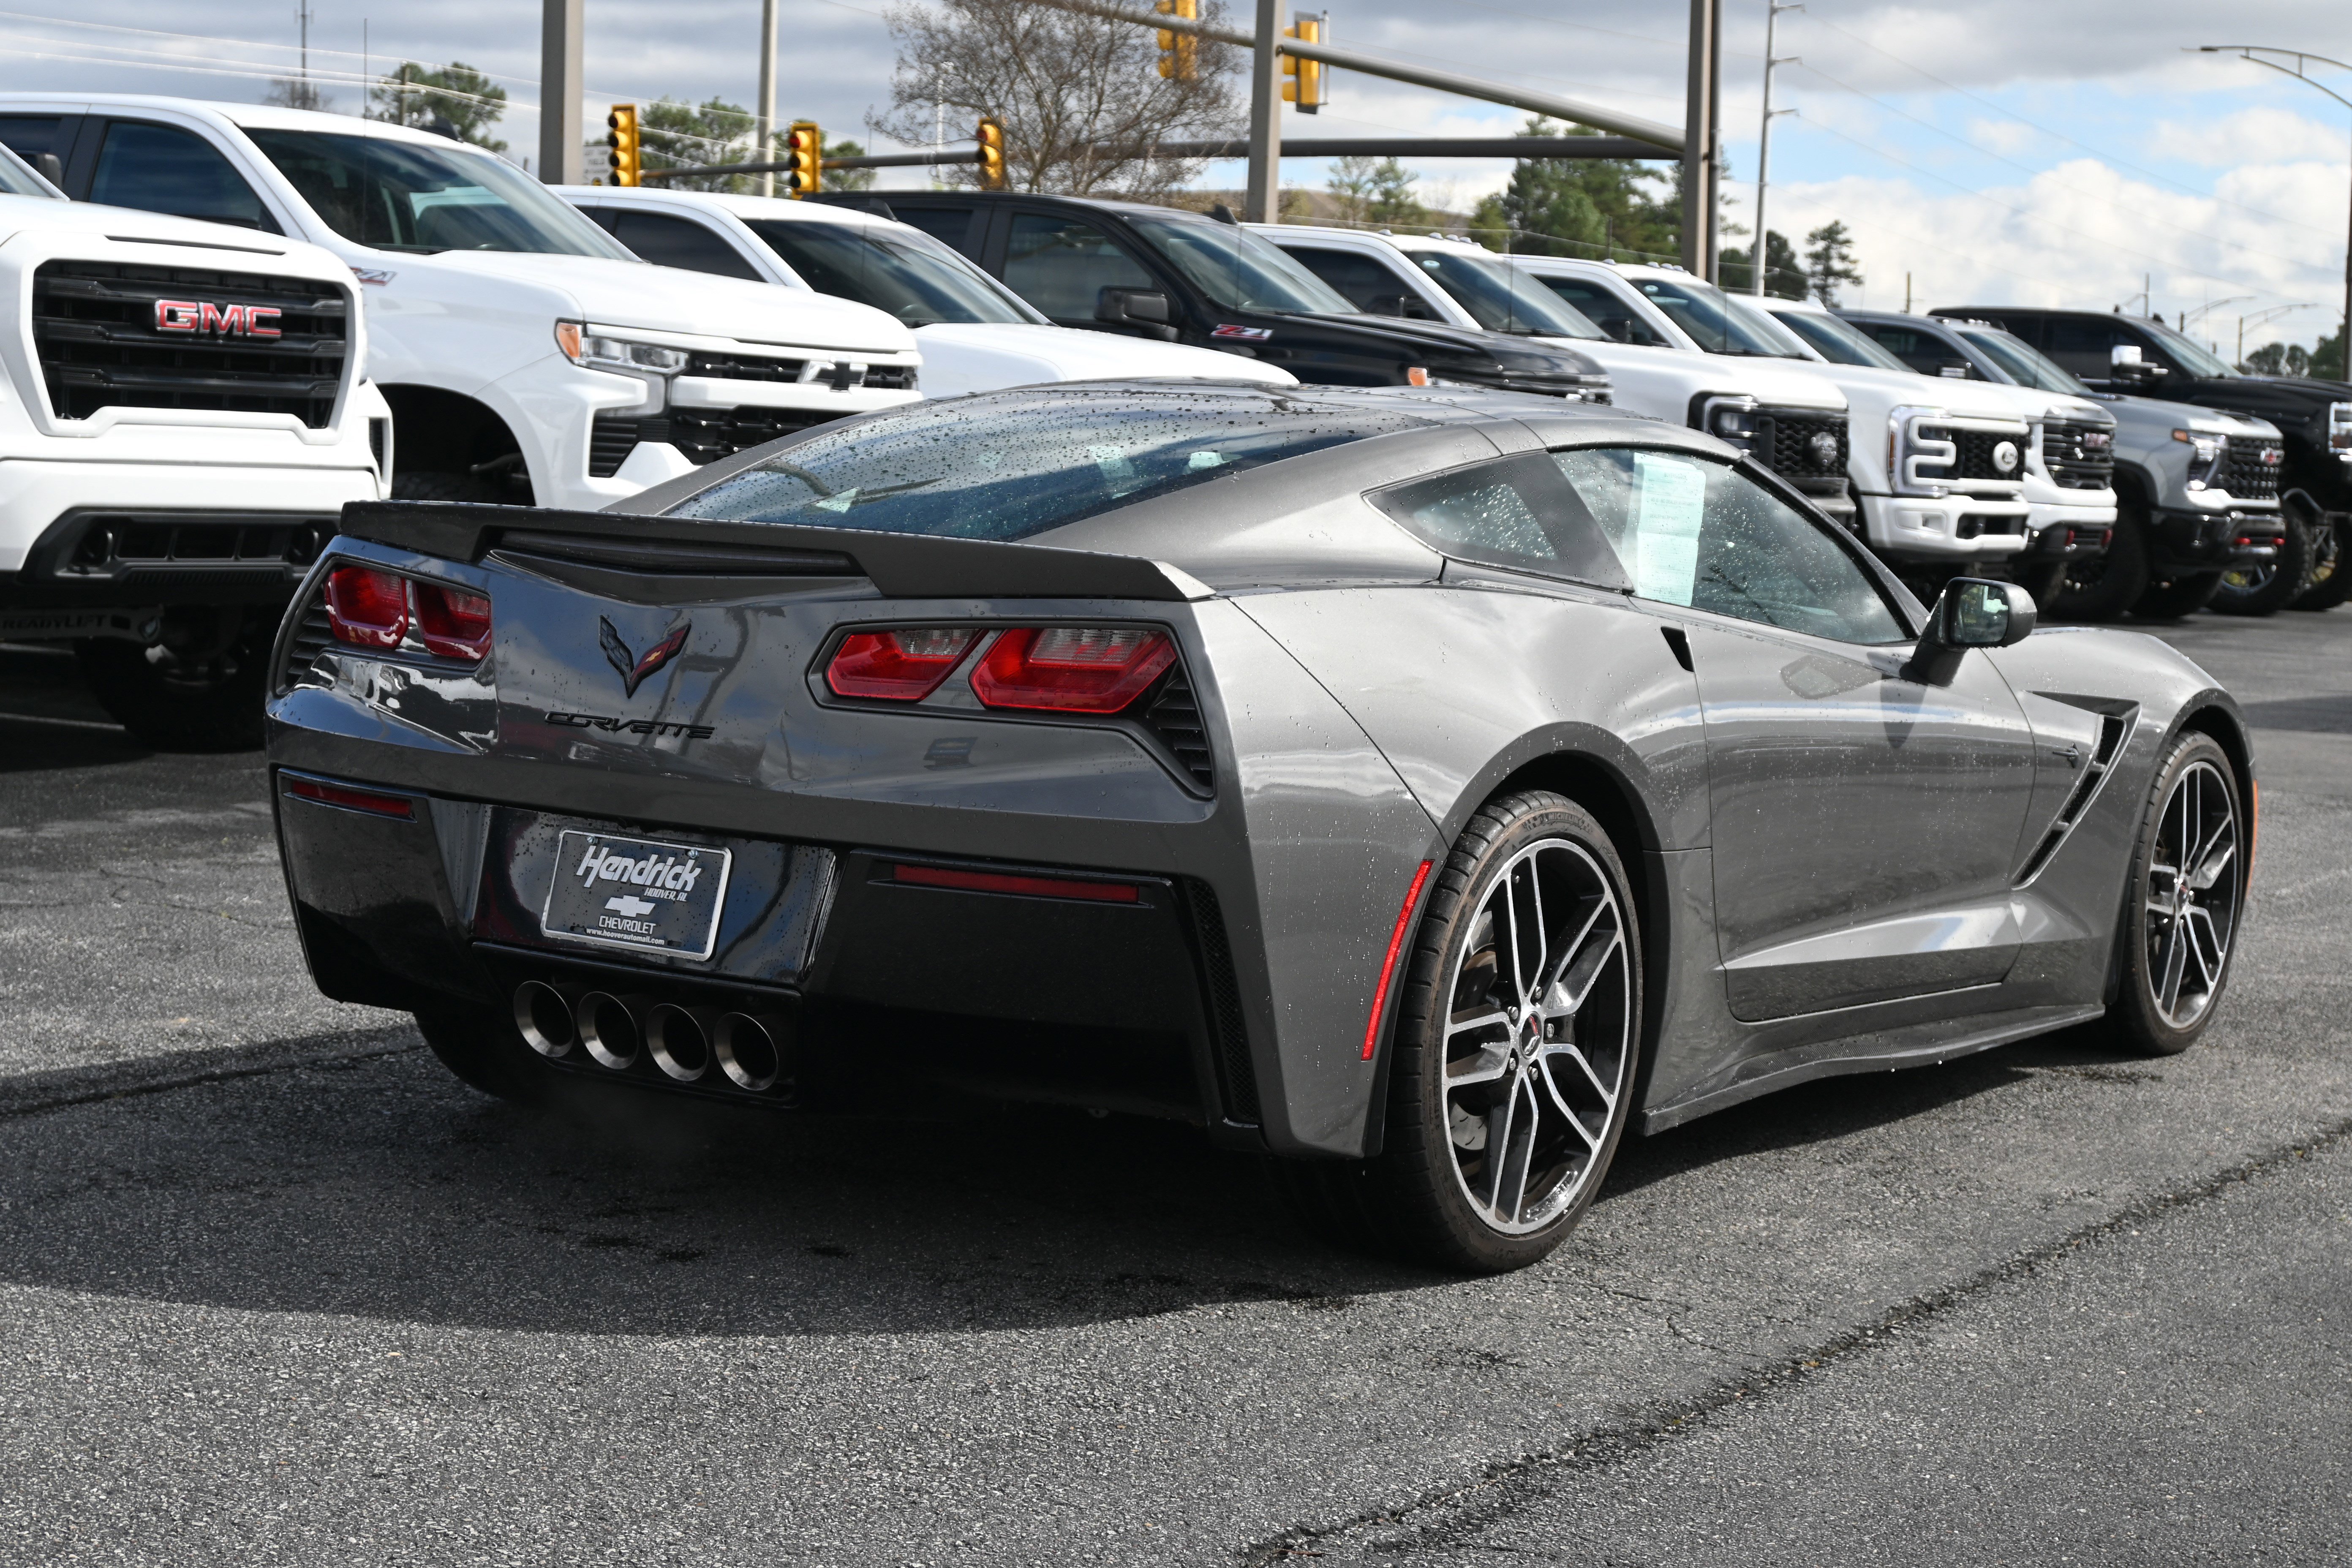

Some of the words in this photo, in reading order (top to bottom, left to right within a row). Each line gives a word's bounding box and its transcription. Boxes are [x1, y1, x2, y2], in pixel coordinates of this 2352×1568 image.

[155, 299, 282, 339] GMC
[1210, 324, 1274, 340] Z71
[545, 710, 716, 739] CORVETTE
[1549, 812, 1579, 824] MICHELIN
[576, 845, 702, 892] Hendrick
[644, 887, 677, 901] HOOVER,
[677, 891, 687, 902] AL
[598, 915, 656, 935] CHEVROLET
[586, 928, 665, 946] www.hooverautomall.com
